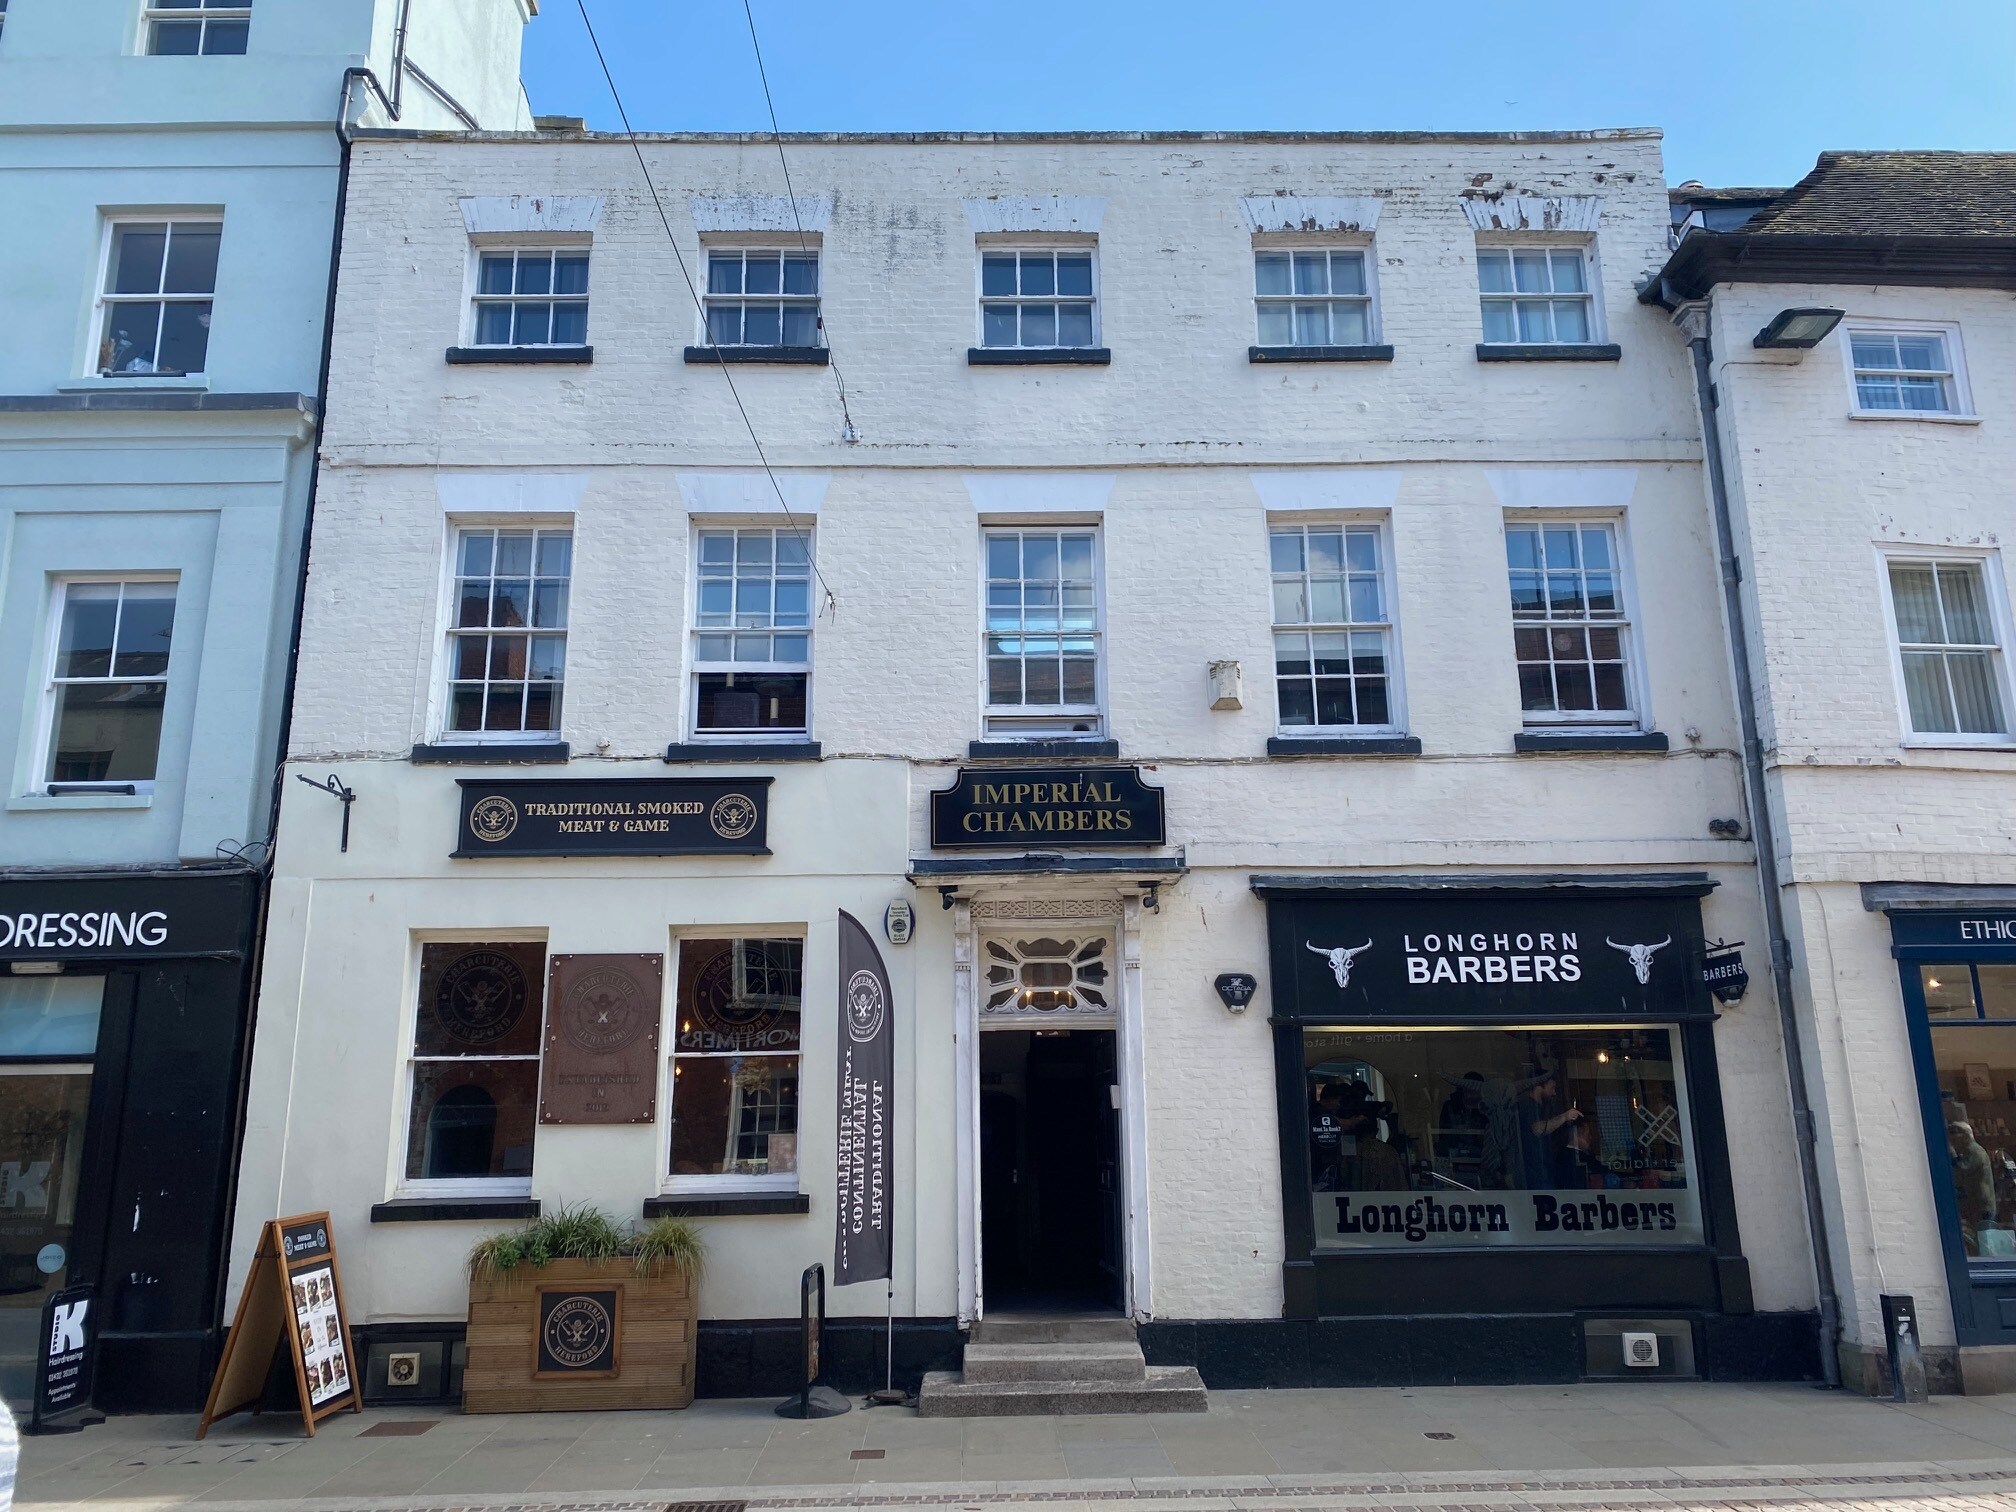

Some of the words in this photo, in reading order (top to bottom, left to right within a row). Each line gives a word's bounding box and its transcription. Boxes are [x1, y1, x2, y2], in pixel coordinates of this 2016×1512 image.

[971, 781, 1122, 805] IMPERIAL
[525, 802, 634, 816] TRADITIONAL
[637, 802, 704, 815] SMOKED
[962, 808, 1132, 833] CHAMBERS
[558, 820, 605, 832] MEAT
[608, 820, 620, 832] &
[623, 819, 670, 832] GAME
[1404, 932, 1578, 952] LONGHORN
[1406, 954, 1582, 984] BARBERS
[1703, 963, 1744, 981] BARBERS
[1334, 1196, 1511, 1243] Longhorn
[1532, 1194, 1678, 1232] Barbers
[552, 1301, 605, 1323] CHARCUTERIE
[51, 1314, 61, 1352] STUDIO
[554, 1345, 599, 1362] HEREFORD
